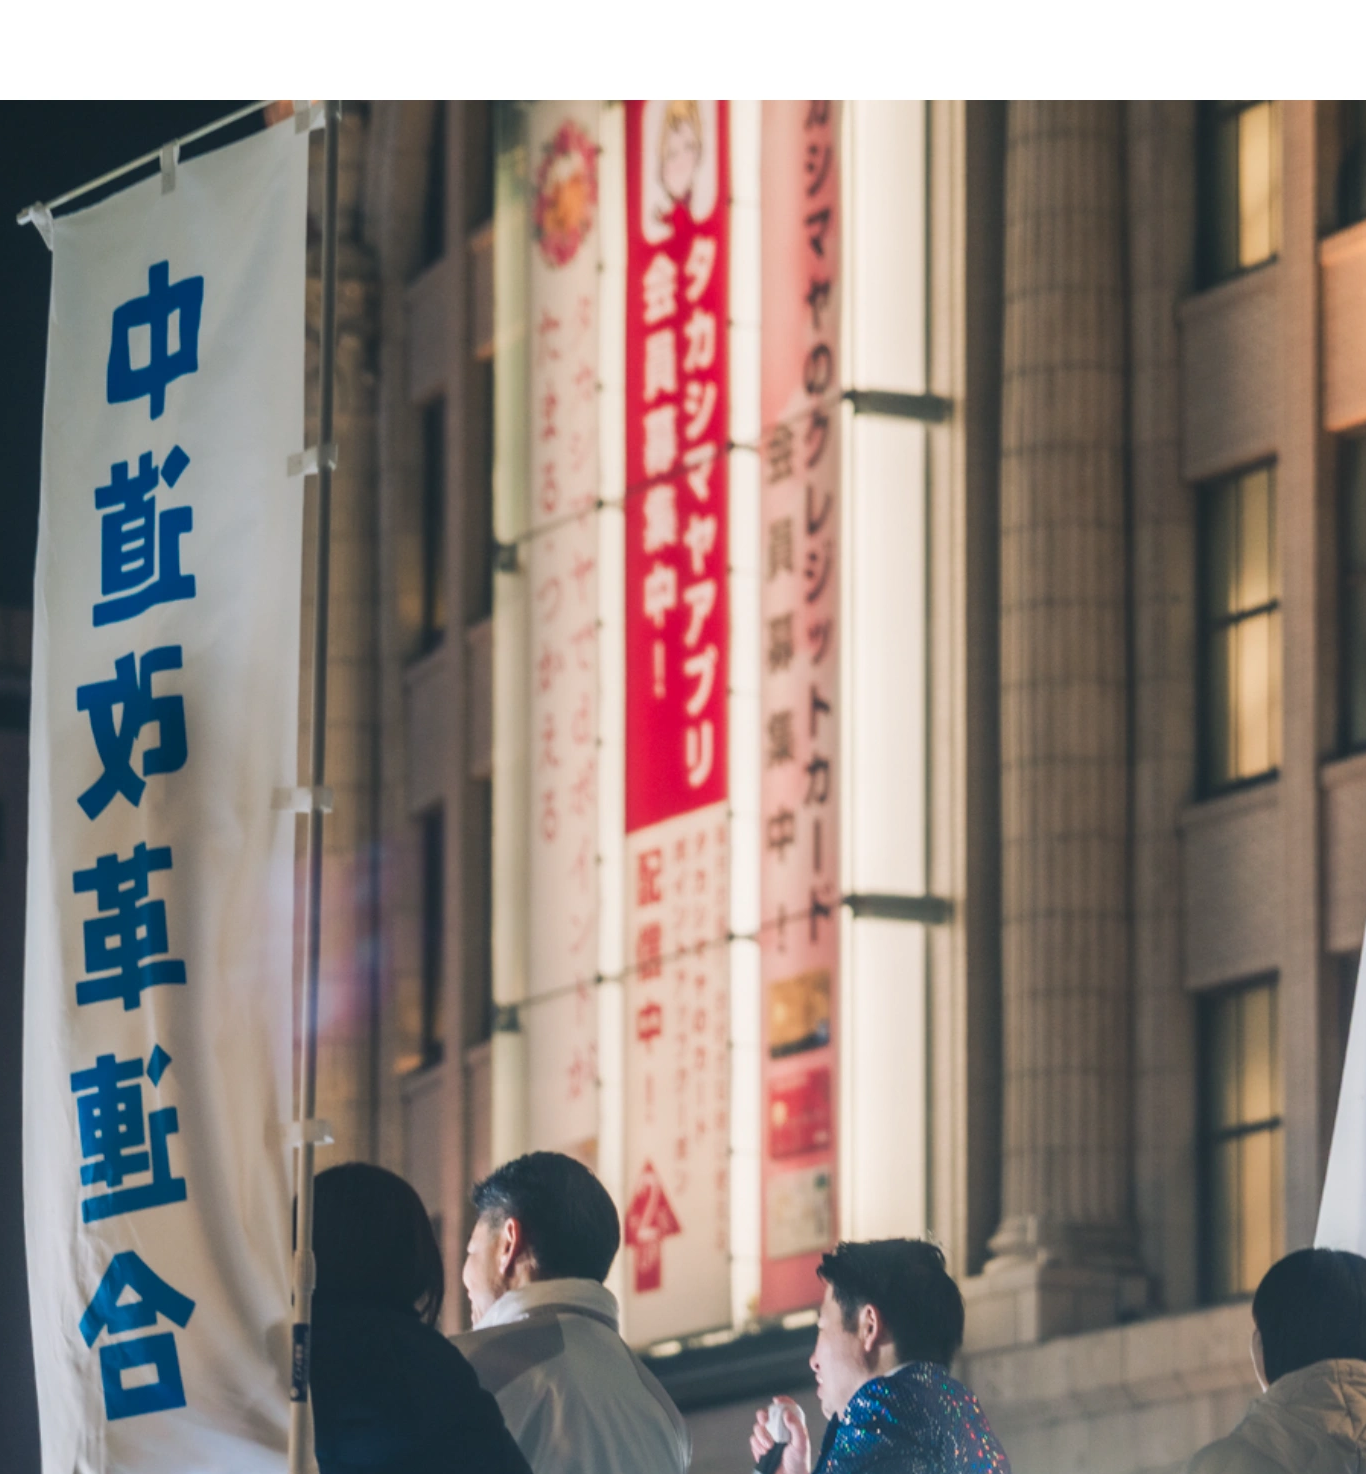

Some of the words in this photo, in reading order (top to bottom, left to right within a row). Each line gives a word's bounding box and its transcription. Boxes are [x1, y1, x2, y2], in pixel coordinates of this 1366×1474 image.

[683, 237, 717, 789] タカシマヤアプリ
